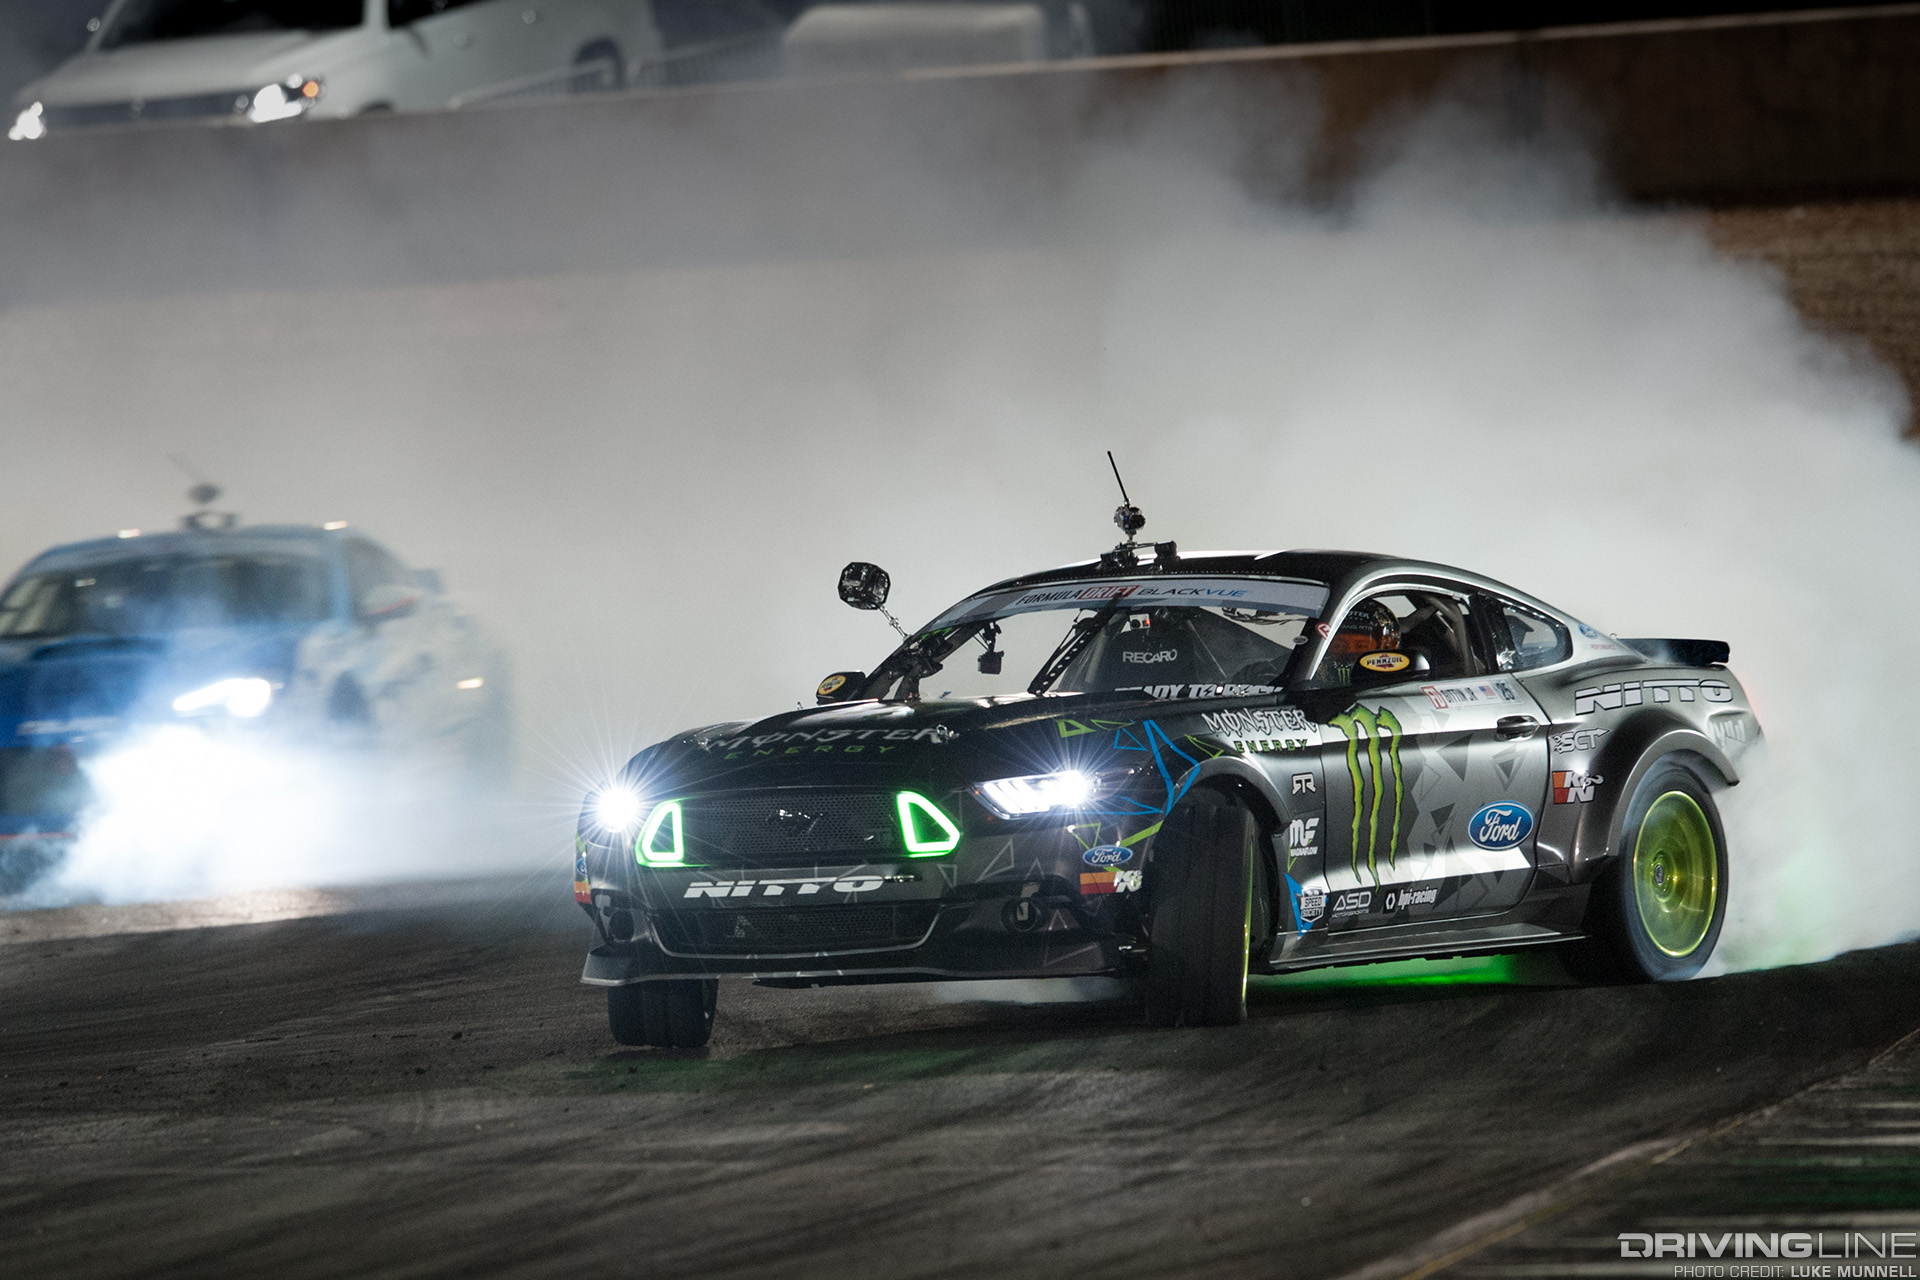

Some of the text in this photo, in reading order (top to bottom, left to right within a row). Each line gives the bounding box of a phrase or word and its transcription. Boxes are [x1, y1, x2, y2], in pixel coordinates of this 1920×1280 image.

[1015, 590, 1081, 605] FORMULA
[1122, 649, 1178, 664] RECARO
[1366, 656, 1404, 666] PENNZOIL
[1574, 678, 1734, 716] NITTO
[1201, 707, 1318, 737] MONSTER
[703, 727, 944, 751] MONSTER
[1233, 739, 1309, 753] ENERGY
[1558, 727, 1611, 753] SCT
[724, 745, 897, 760] ENERGY
[1291, 773, 1317, 795] RTR
[1478, 808, 1522, 843] Ford
[1091, 848, 1123, 864] Ford
[683, 875, 885, 898] NITTO
[1303, 896, 1323, 907] SPEED
[1332, 891, 1372, 912] ASD
[1301, 908, 1322, 918] SOCIETY
